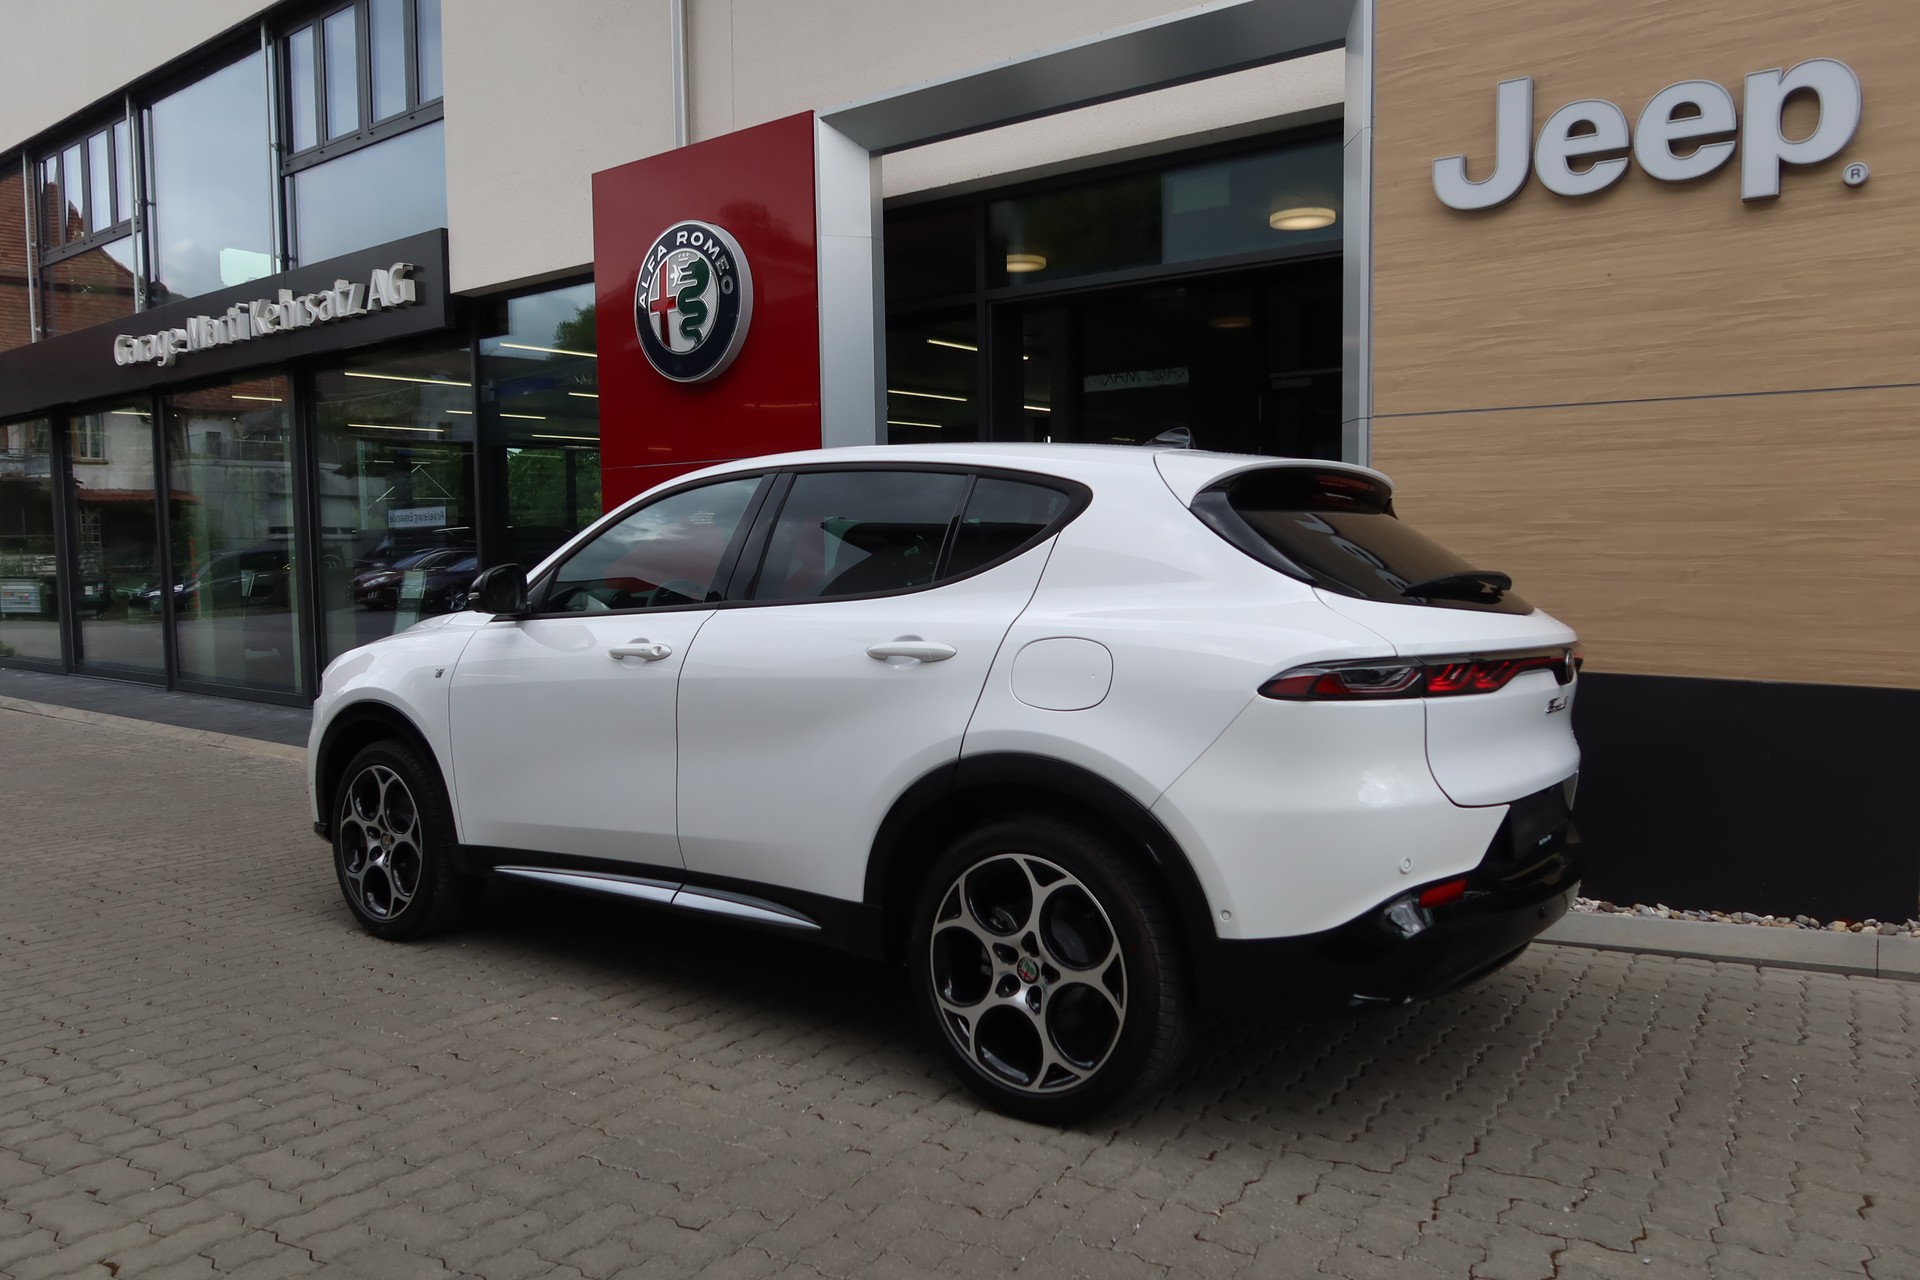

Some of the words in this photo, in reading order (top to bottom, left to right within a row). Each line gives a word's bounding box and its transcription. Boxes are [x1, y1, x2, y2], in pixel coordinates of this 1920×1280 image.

[1432, 57, 1863, 211] Jeep
[113, 327, 187, 367] Garage
[187, 302, 250, 352] Marti
[249, 278, 367, 337] Kehrsatz
[366, 261, 416, 312] AG
[638, 245, 667, 309] ALFA
[676, 230, 734, 295] ROMEO
